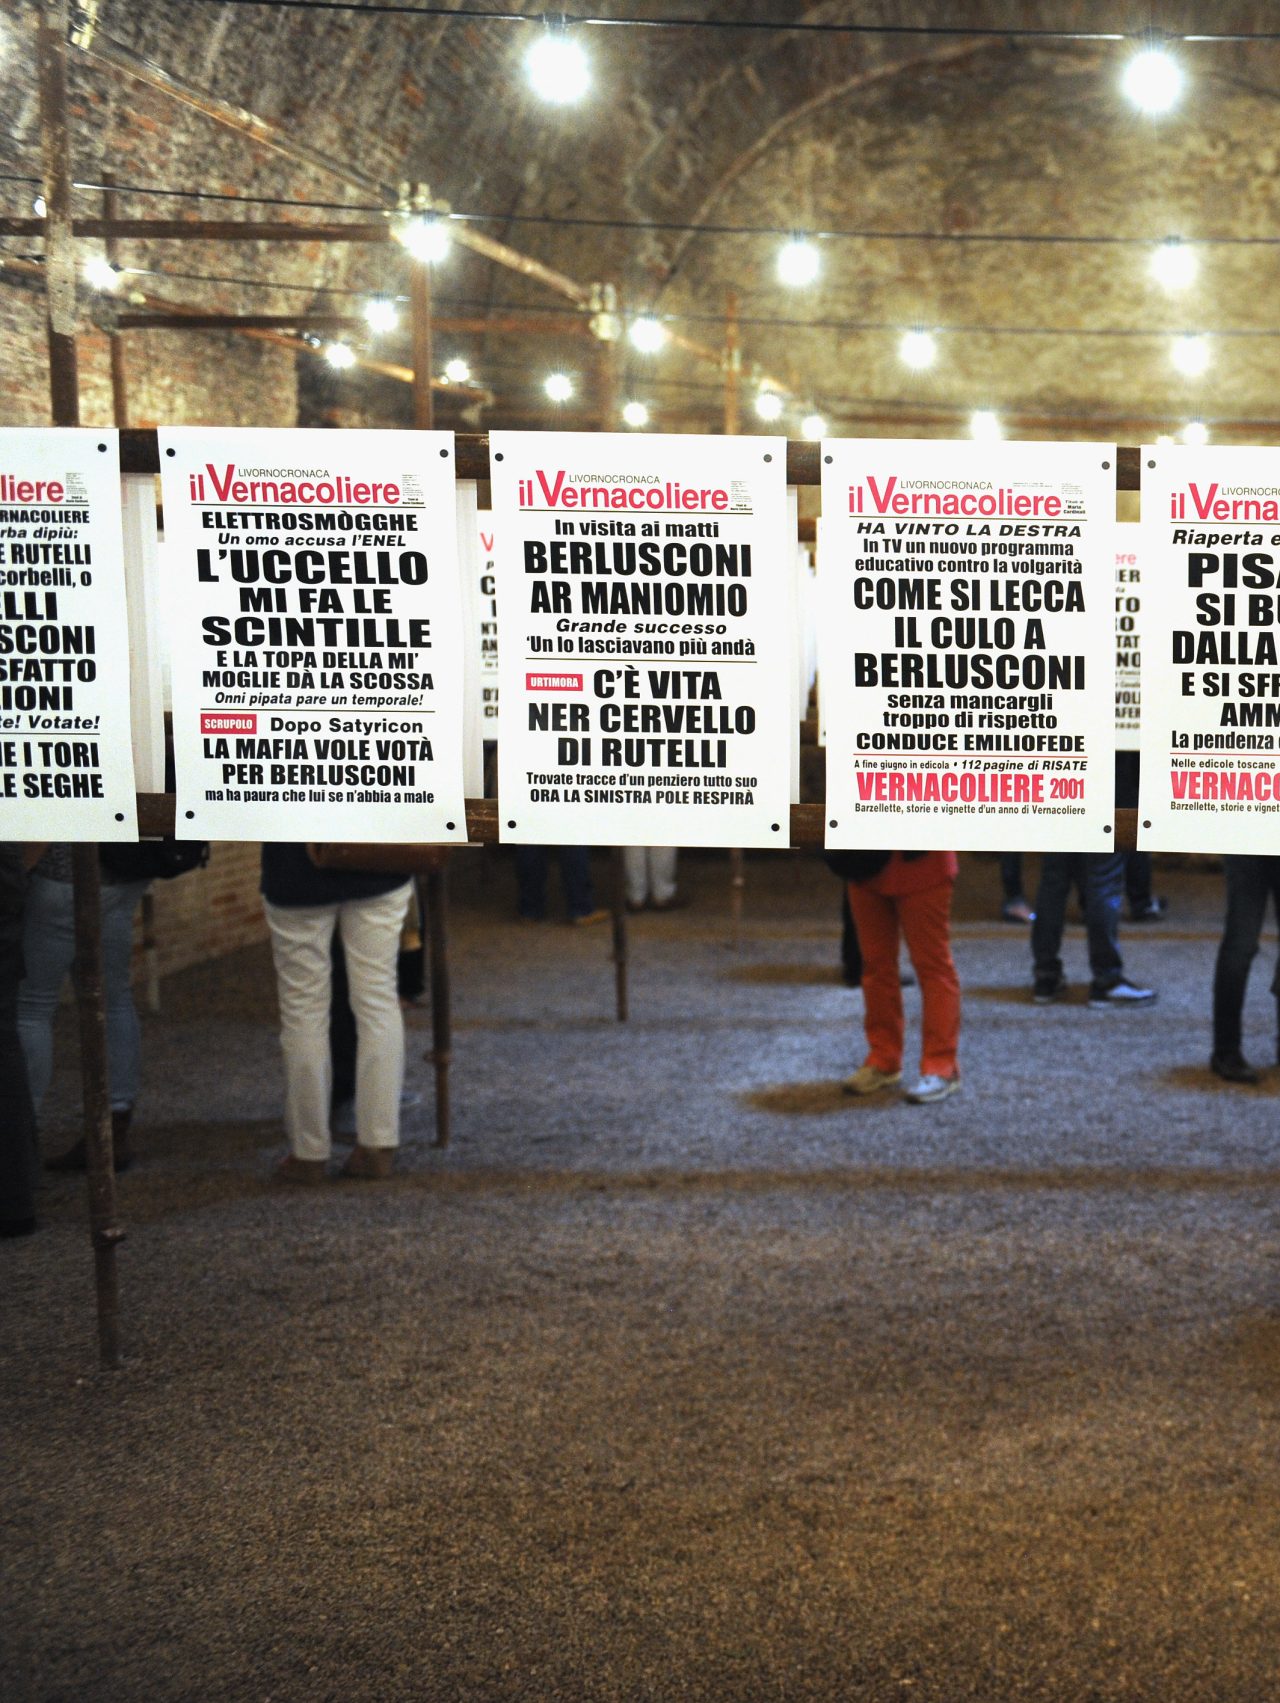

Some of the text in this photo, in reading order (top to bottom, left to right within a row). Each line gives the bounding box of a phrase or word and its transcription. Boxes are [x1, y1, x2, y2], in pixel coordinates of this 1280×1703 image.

[190, 475, 204, 500] il
[206, 464, 400, 504] Vernacoliere
[238, 469, 329, 478] LIVORNOCRONACA
[519, 479, 533, 507] il
[536, 470, 728, 509] Vernacoliere
[849, 487, 862, 513] il
[867, 476, 1061, 516] Vernacoliere
[901, 481, 992, 490] LIVORNOCRONACA
[1171, 493, 1184, 520] il
[201, 509, 419, 532] ELETTROSMÒGGHE
[554, 518, 720, 538] In visita ai matti
[856, 522, 1082, 538] HA VINTO LA DESTRA
[32, 526, 79, 541] dipiù:
[217, 532, 241, 545] Un
[245, 535, 280, 546] omo
[284, 536, 347, 547] accusa
[1172, 528, 1264, 549] Riaperta
[10, 542, 92, 566] RUTELLI
[523, 540, 752, 578] BERLUSCONI
[196, 548, 429, 586] L'UCCELLO
[855, 556, 1083, 576] educativo contro la volgarità
[530, 580, 748, 618] AR MANIOMIO
[1195, 592, 1236, 627] SI
[201, 615, 433, 649] SCINTILLE
[555, 618, 728, 635] Grande successo
[1172, 630, 1279, 666] DALLA
[202, 669, 435, 691] MOGLIE DÀ LA SCOSSA
[530, 676, 579, 689] URTIMORA
[854, 652, 1086, 691] BERLUSCONI
[28, 714, 101, 730] Votate!
[204, 718, 253, 731] SCRUPOLO
[270, 716, 424, 737] Dopo Satyricon
[528, 702, 756, 735] NER CERVELLO
[856, 732, 1086, 753] CONDUCE EMILIOFEDE
[23, 741, 100, 768] I TORI
[1171, 758, 1197, 768] Nelle
[1198, 758, 1235, 769] edicole
[1237, 760, 1276, 770] toscane
[22, 772, 105, 799] SEGHE
[221, 763, 416, 787] PER BERLUSCONI
[525, 771, 574, 786] Trovate
[575, 773, 617, 786] tracce
[647, 774, 701, 788] penziero
[703, 775, 733, 788] tutto
[735, 776, 758, 788] suo
[855, 771, 1085, 803] VERNACOLIERE 2001
